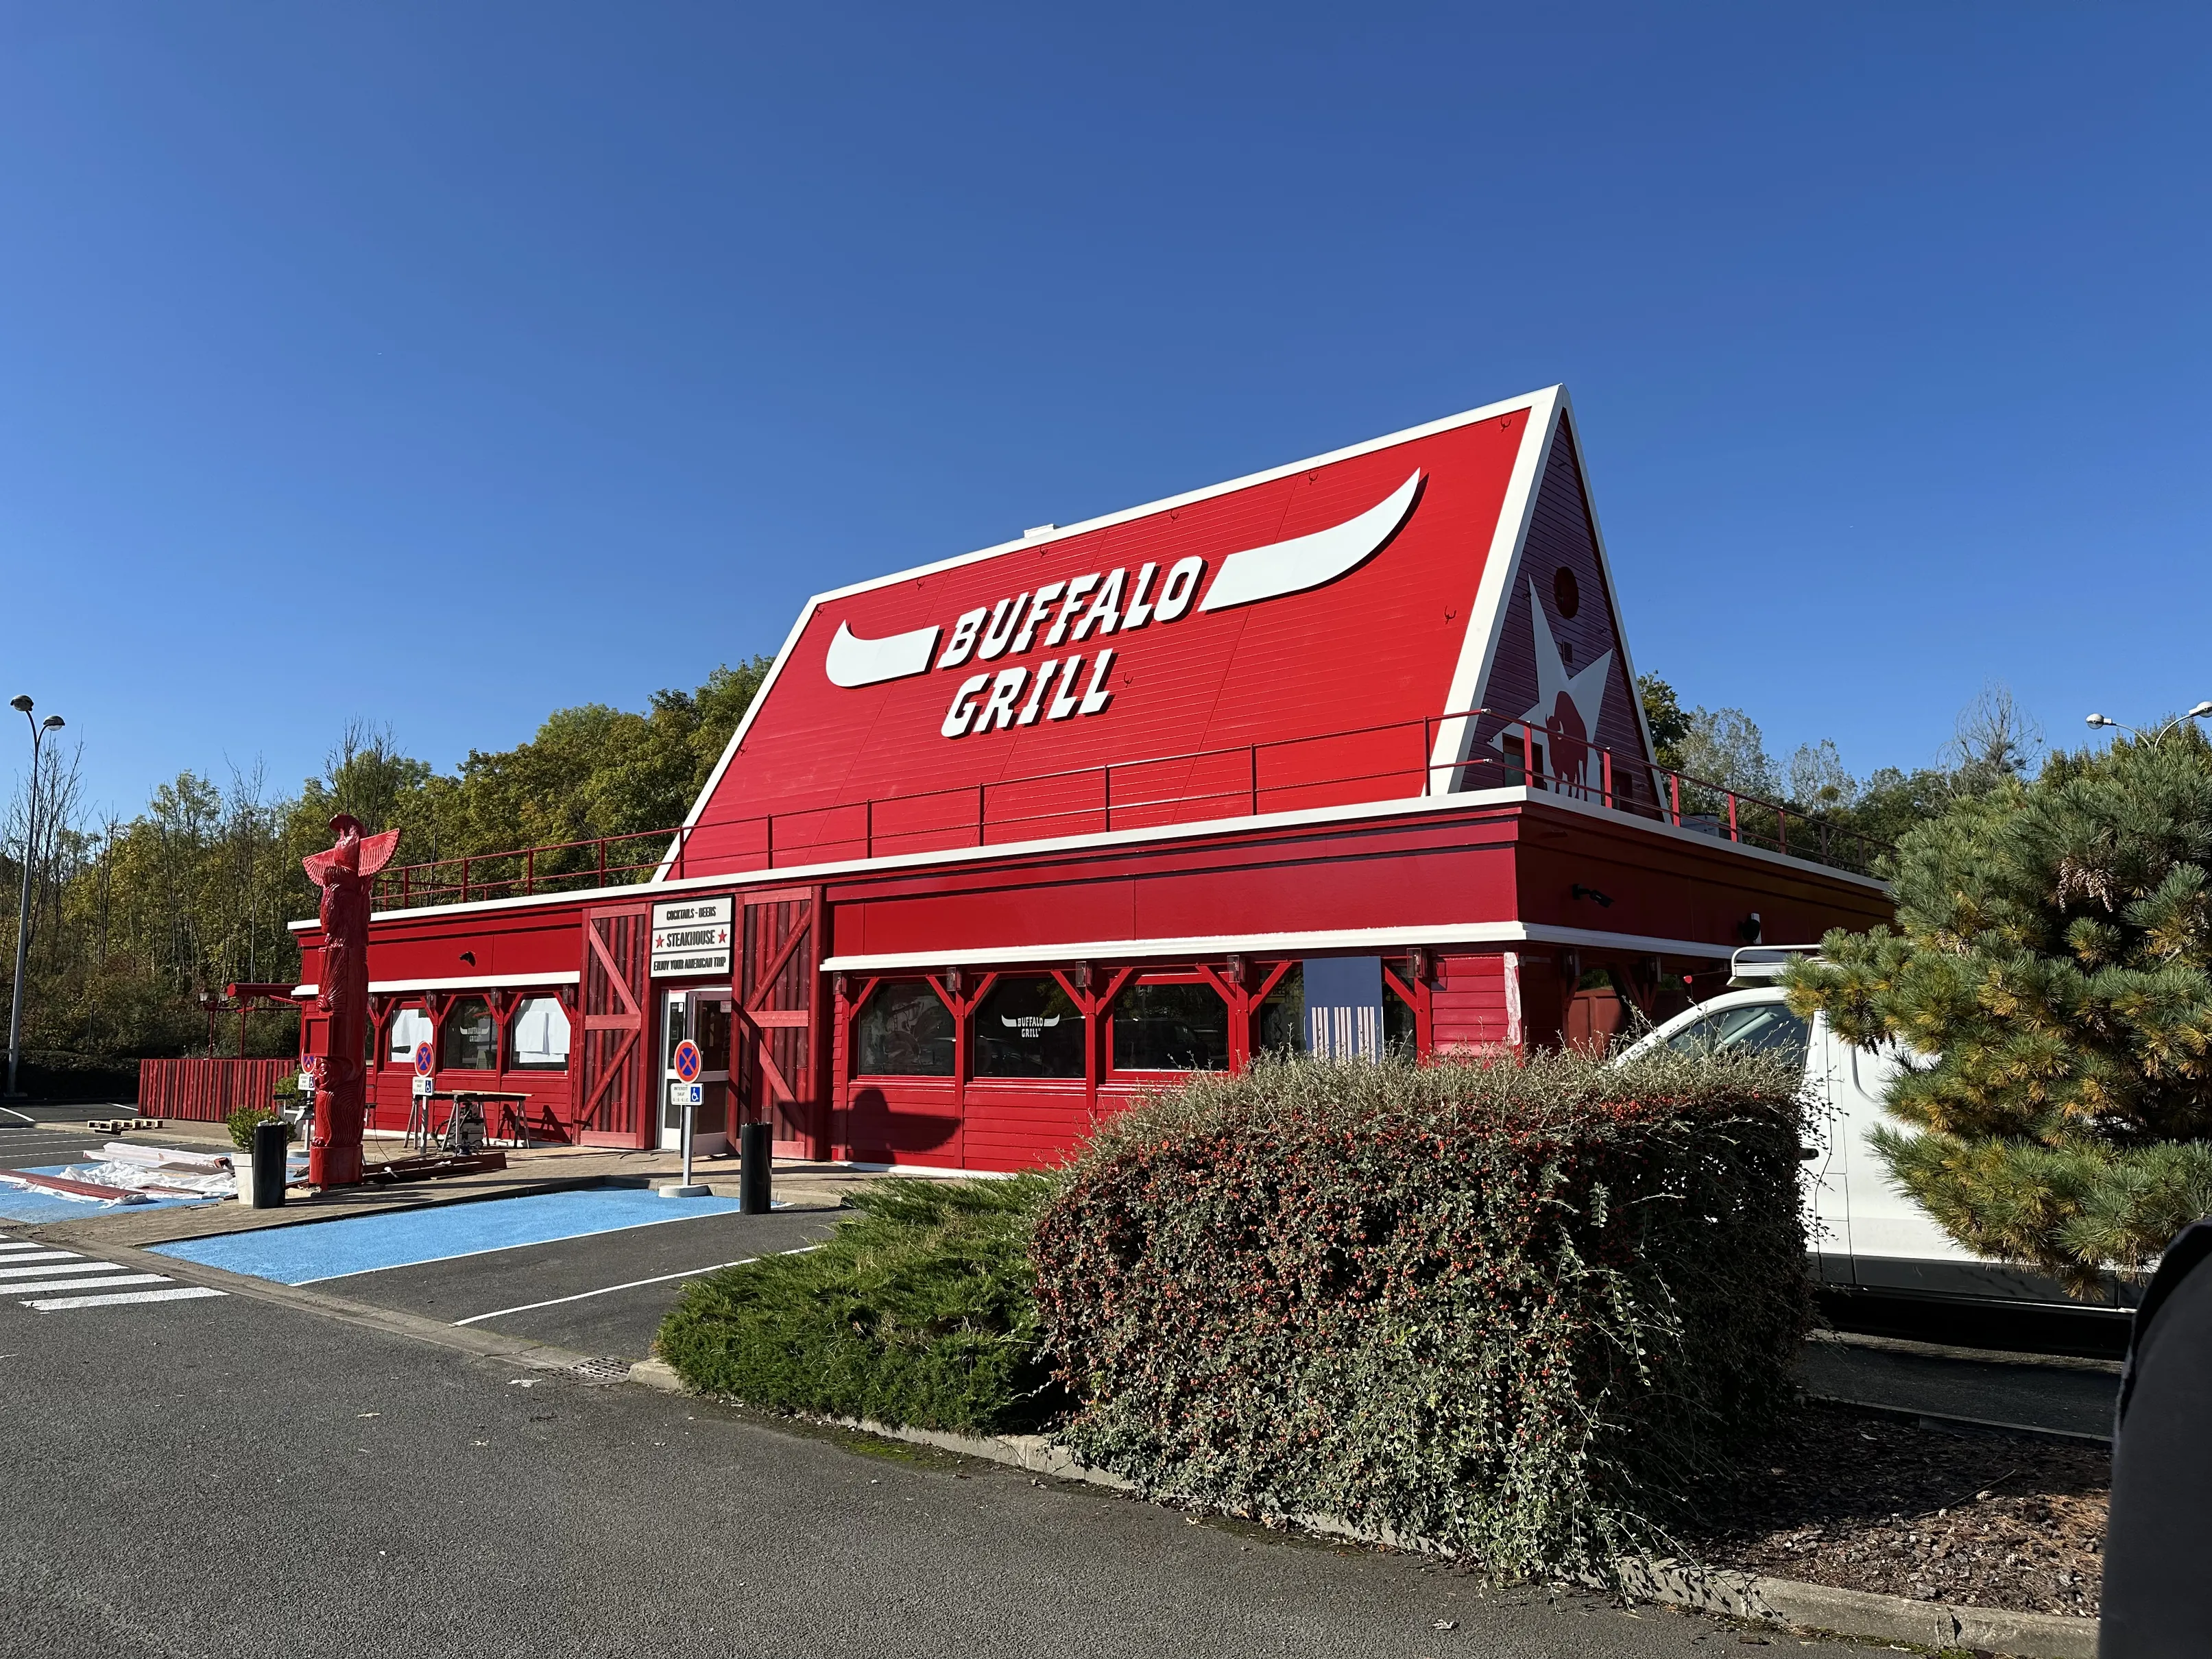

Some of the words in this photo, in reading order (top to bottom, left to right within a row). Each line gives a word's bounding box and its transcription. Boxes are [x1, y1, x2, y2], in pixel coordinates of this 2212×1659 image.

[936, 556, 1204, 669] BUFFALO
[941, 648, 1115, 738] GRILL
[666, 908, 695, 921] COCKTAILS
[699, 906, 717, 917] BEERS
[666, 930, 715, 947] STEAKHOUSE
[684, 957, 713, 969] AMERICAN
[714, 956, 726, 967] TRIP
[1017, 1016, 1044, 1027] BUFFALO
